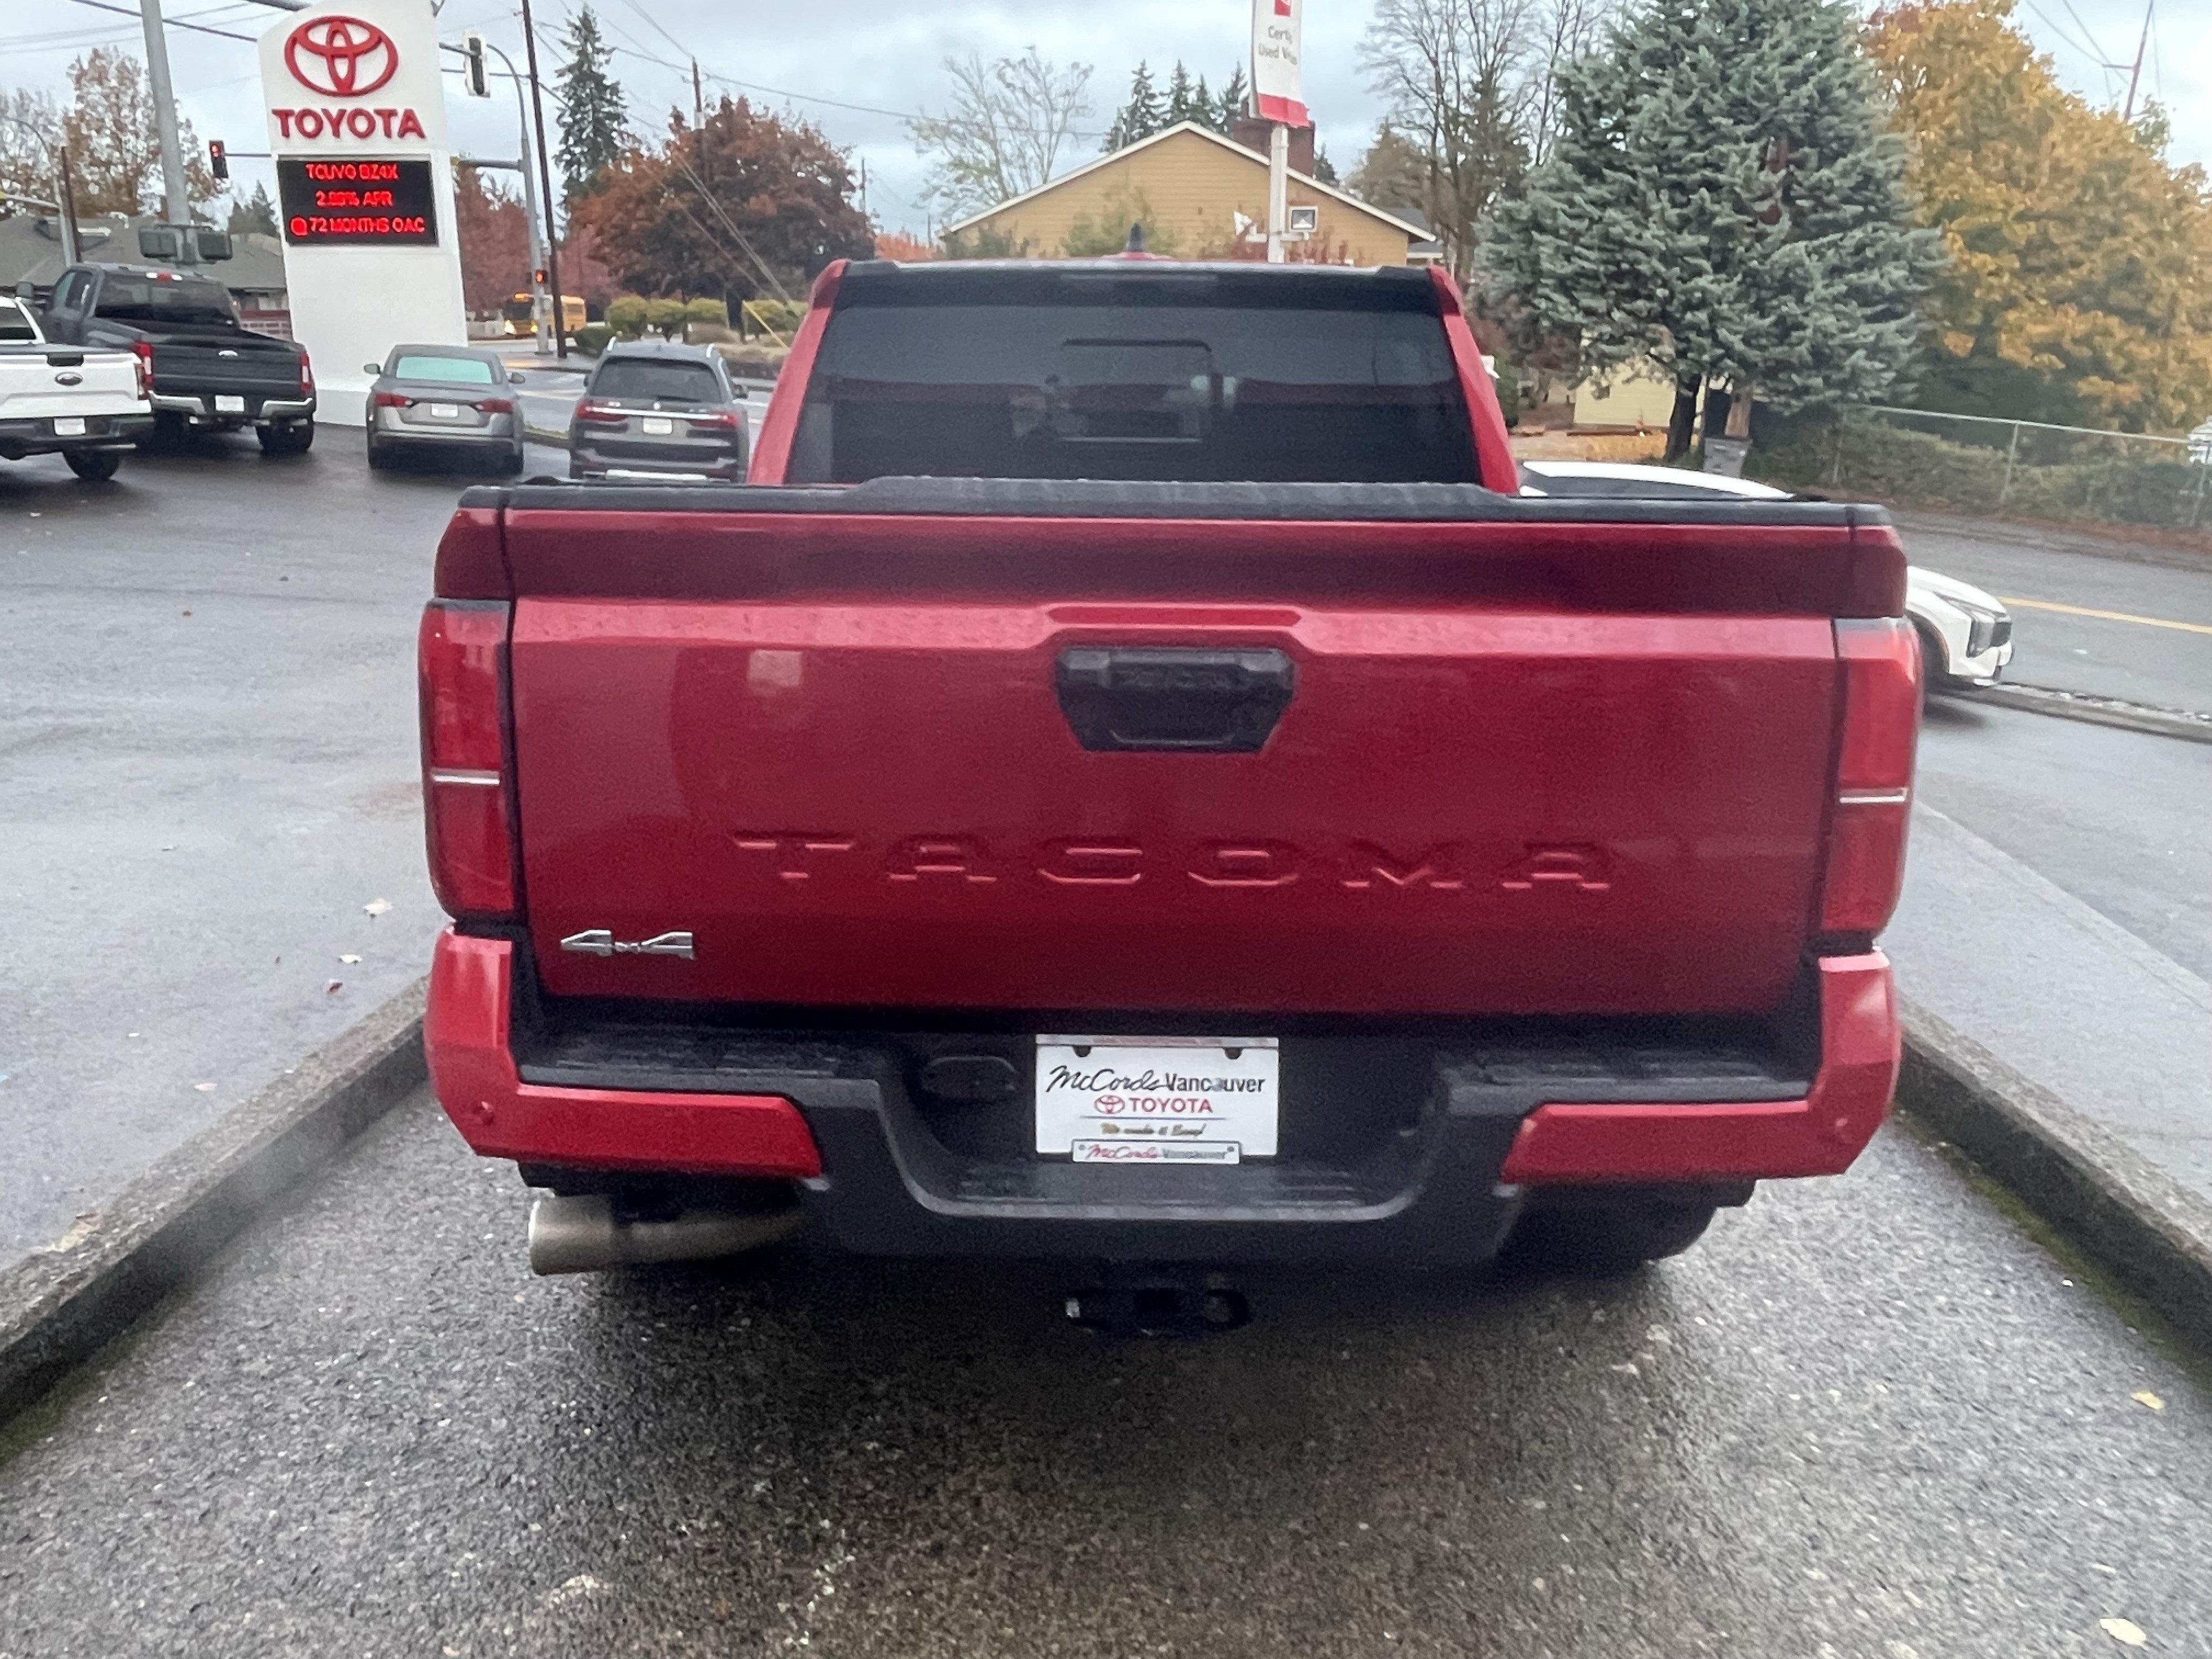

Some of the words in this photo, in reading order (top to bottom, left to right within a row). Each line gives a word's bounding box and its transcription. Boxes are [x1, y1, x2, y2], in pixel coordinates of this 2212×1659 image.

[272, 109, 426, 139] TOYOTA
[309, 217, 328, 233] 72
[392, 217, 426, 233] OAC
[735, 834, 1611, 892] TACOMA
[1128, 1097, 1213, 1113] TOYOTA
